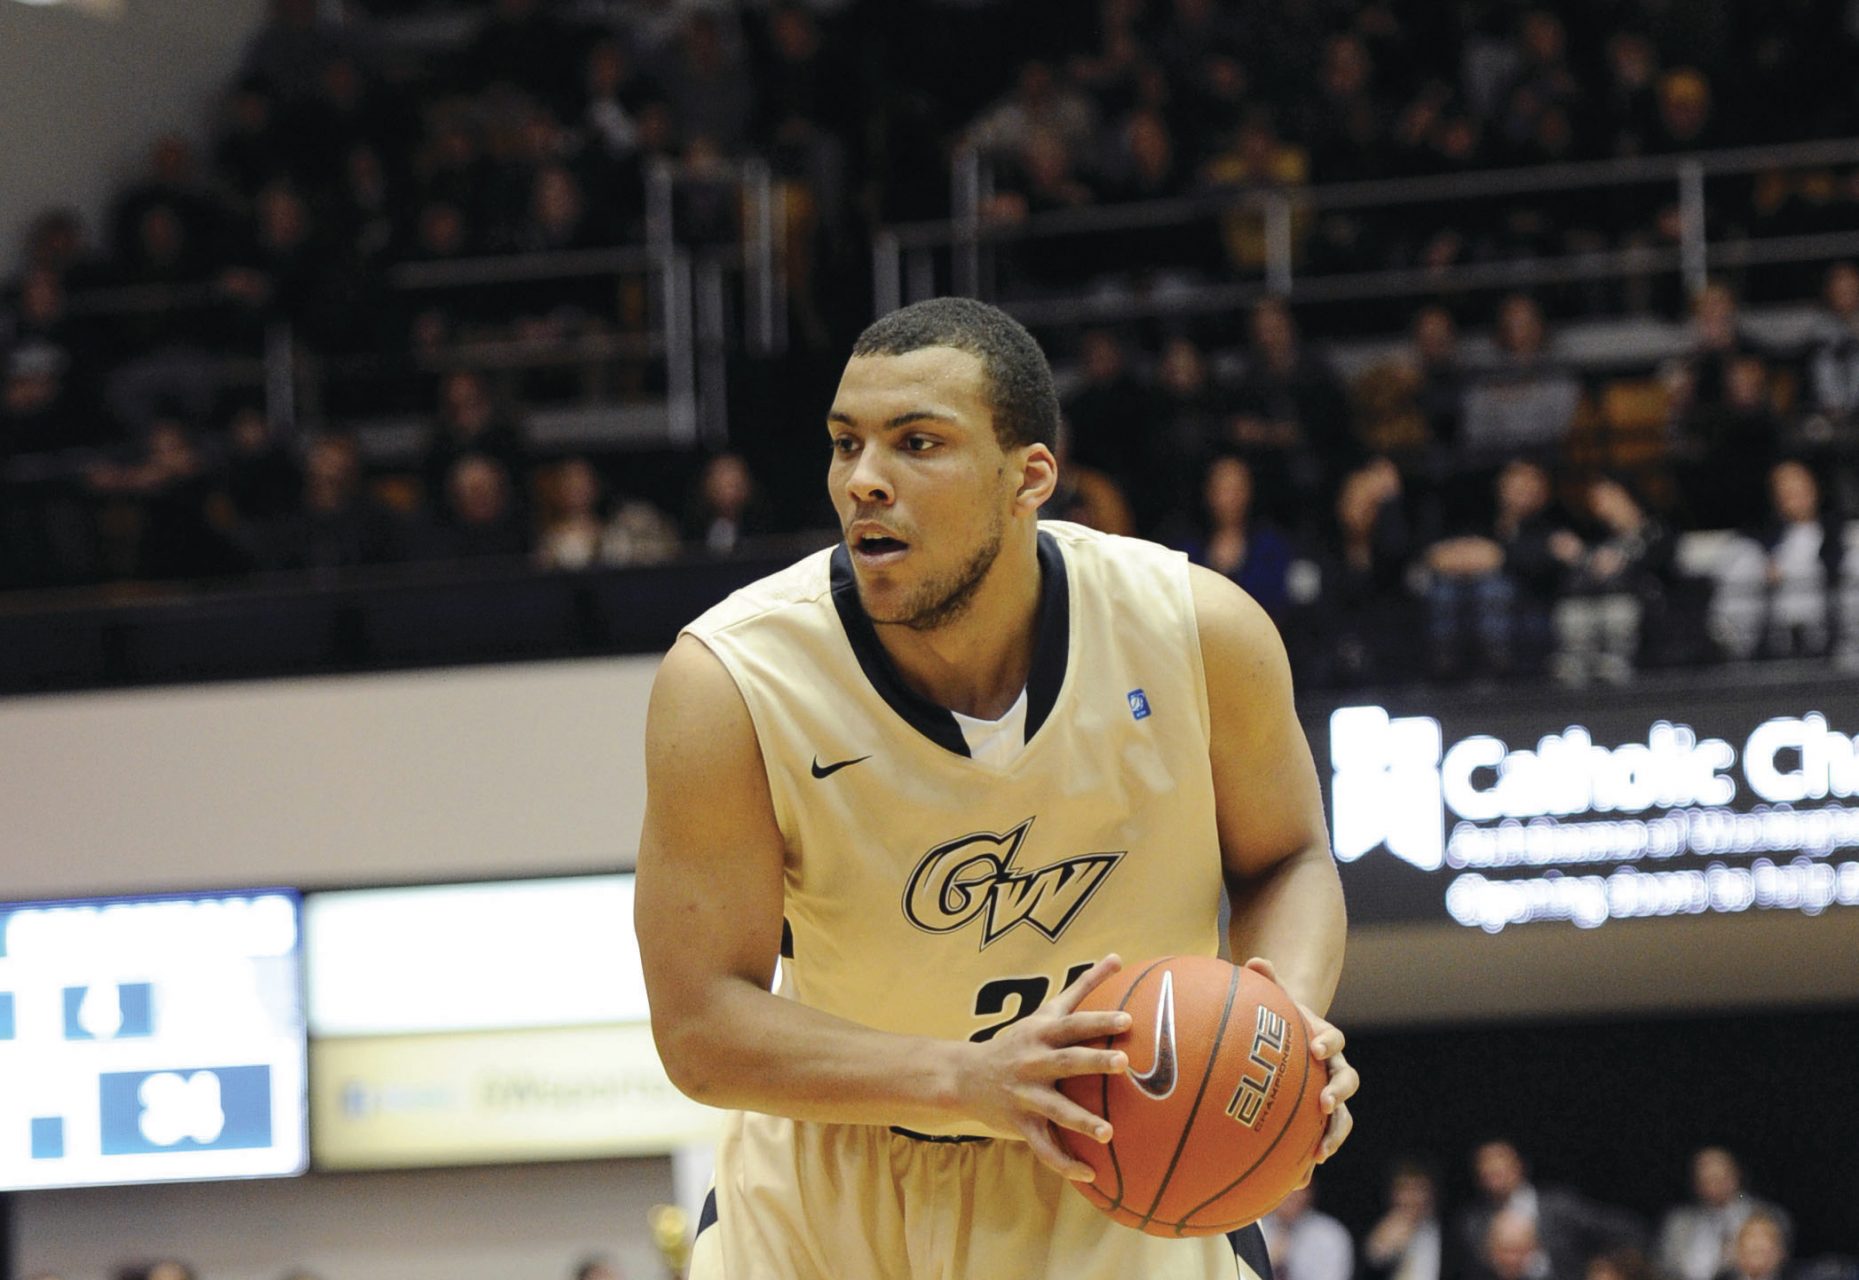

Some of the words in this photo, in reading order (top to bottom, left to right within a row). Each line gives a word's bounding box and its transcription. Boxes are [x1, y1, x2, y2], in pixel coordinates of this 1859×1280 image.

[1743, 711, 1859, 802] Ch
[901, 815, 1127, 952] GW
[1225, 1005, 1286, 1128] ELITE
